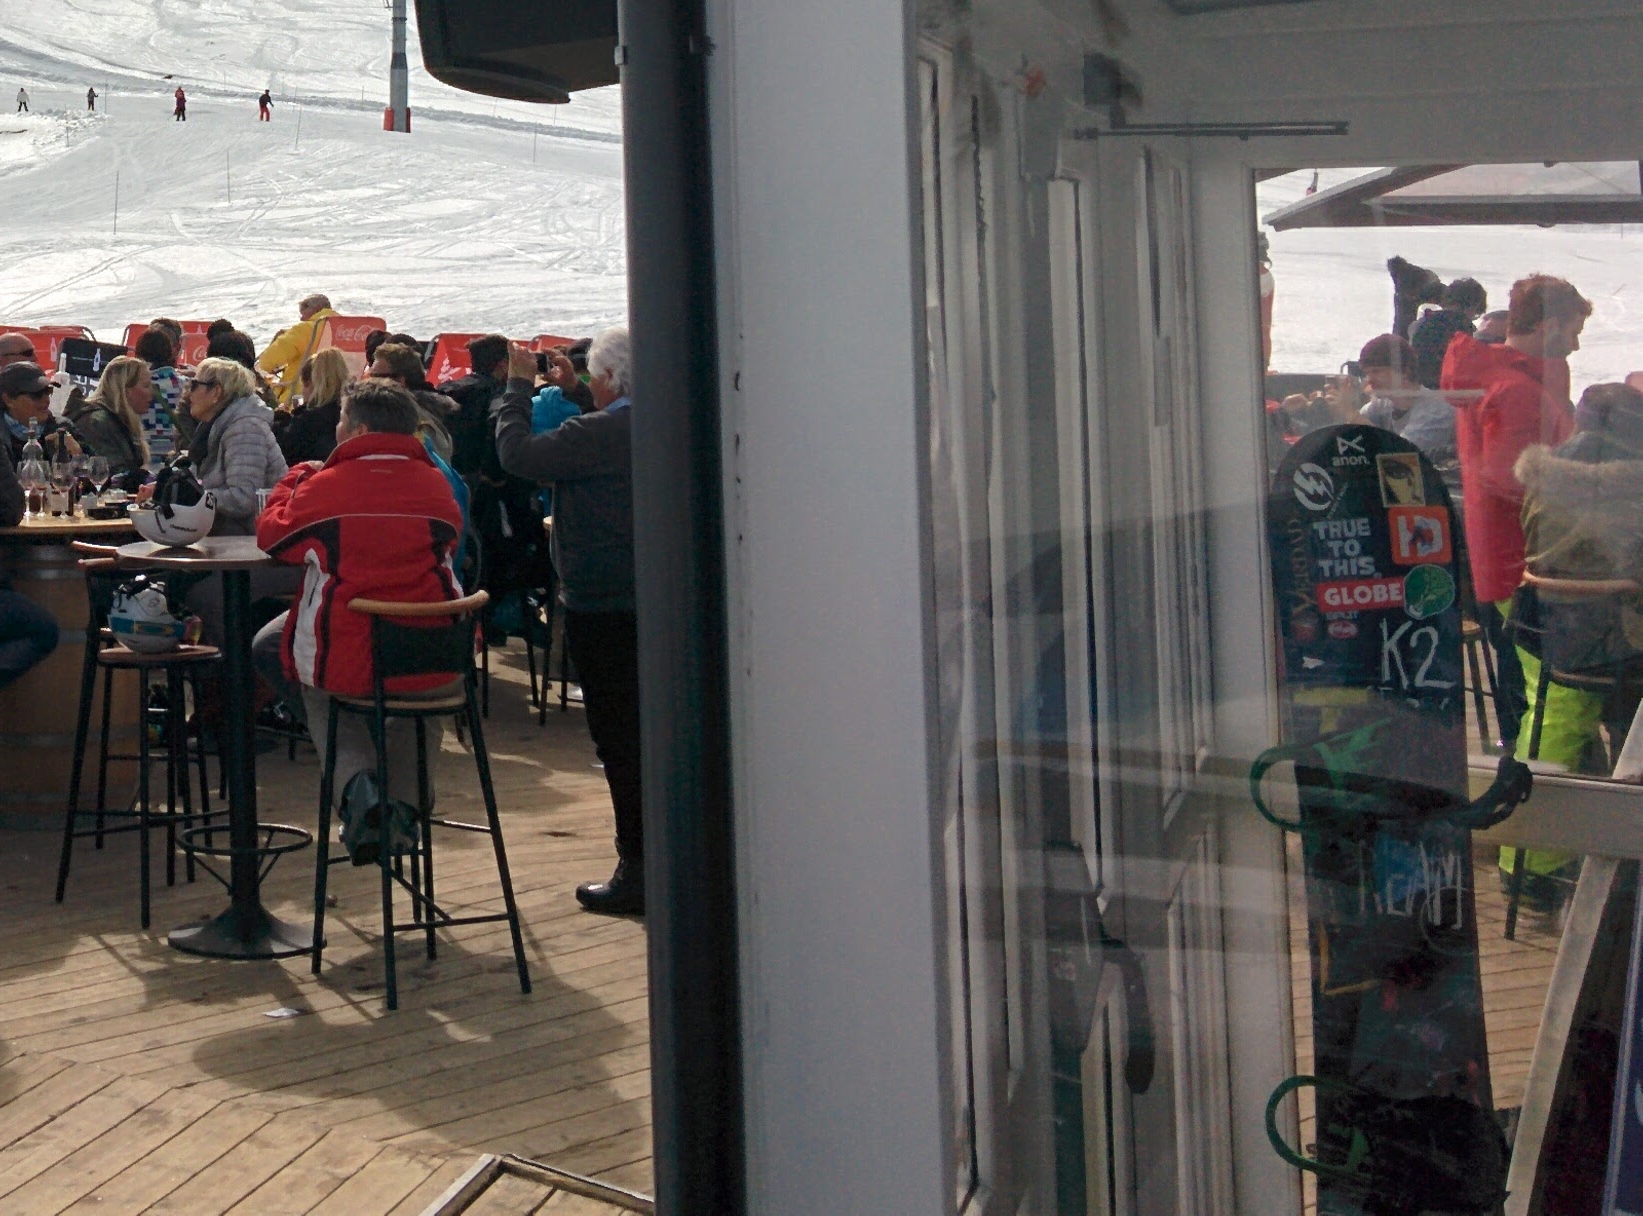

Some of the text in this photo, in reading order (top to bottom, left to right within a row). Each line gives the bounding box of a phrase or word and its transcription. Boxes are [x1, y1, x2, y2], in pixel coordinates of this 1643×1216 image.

[1312, 517, 1372, 540] TRUE
[1327, 539, 1362, 557] TO
[1324, 583, 1403, 606] GLOBE
[1380, 617, 1457, 690] K2
